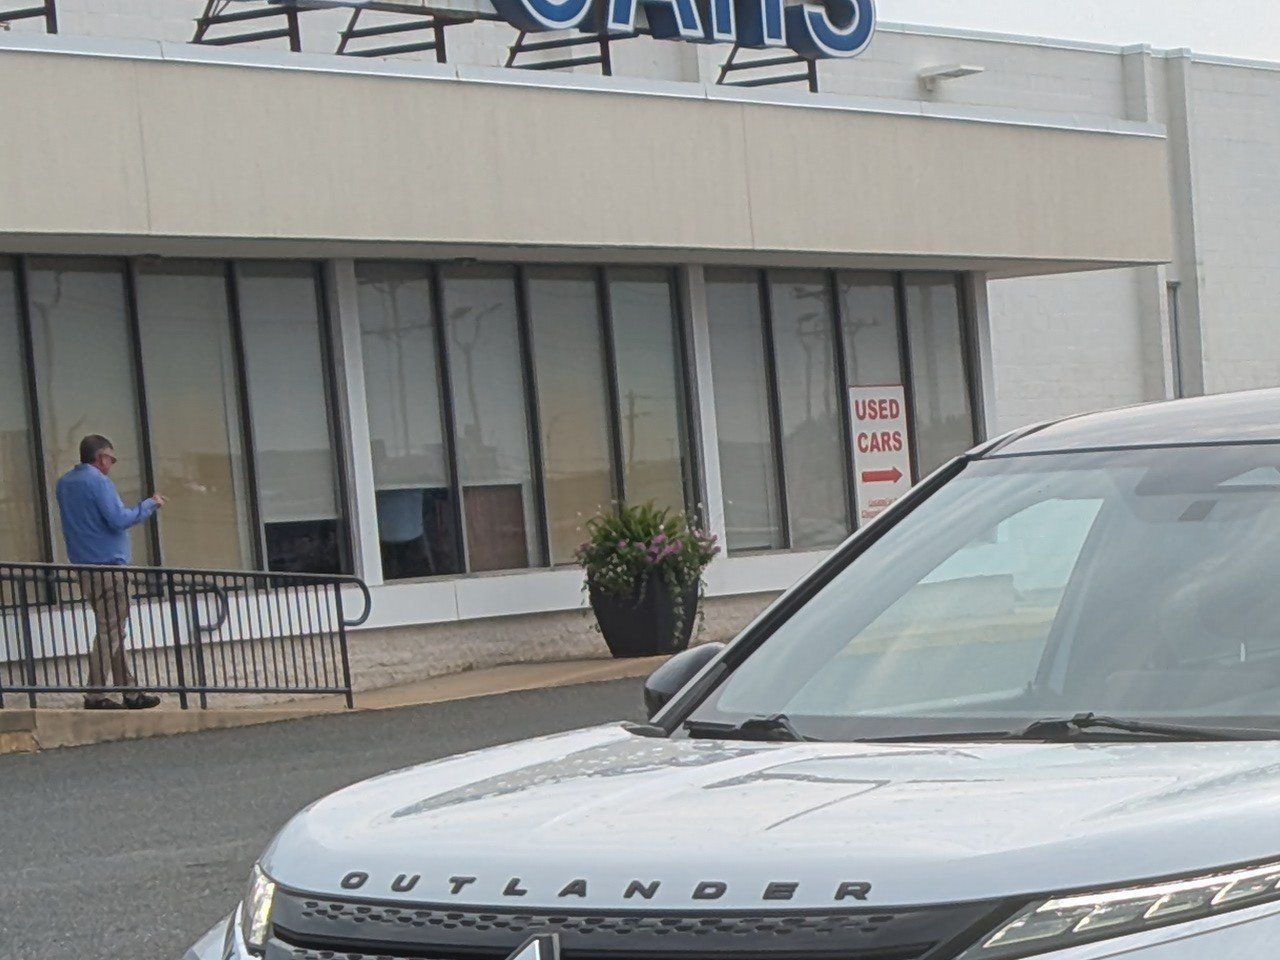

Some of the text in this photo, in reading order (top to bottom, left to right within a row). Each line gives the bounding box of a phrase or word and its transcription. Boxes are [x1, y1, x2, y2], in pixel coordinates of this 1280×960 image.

[855, 399, 900, 420] USED
[857, 431, 902, 453] CARS
[340, 870, 872, 901] OUTLANDER
